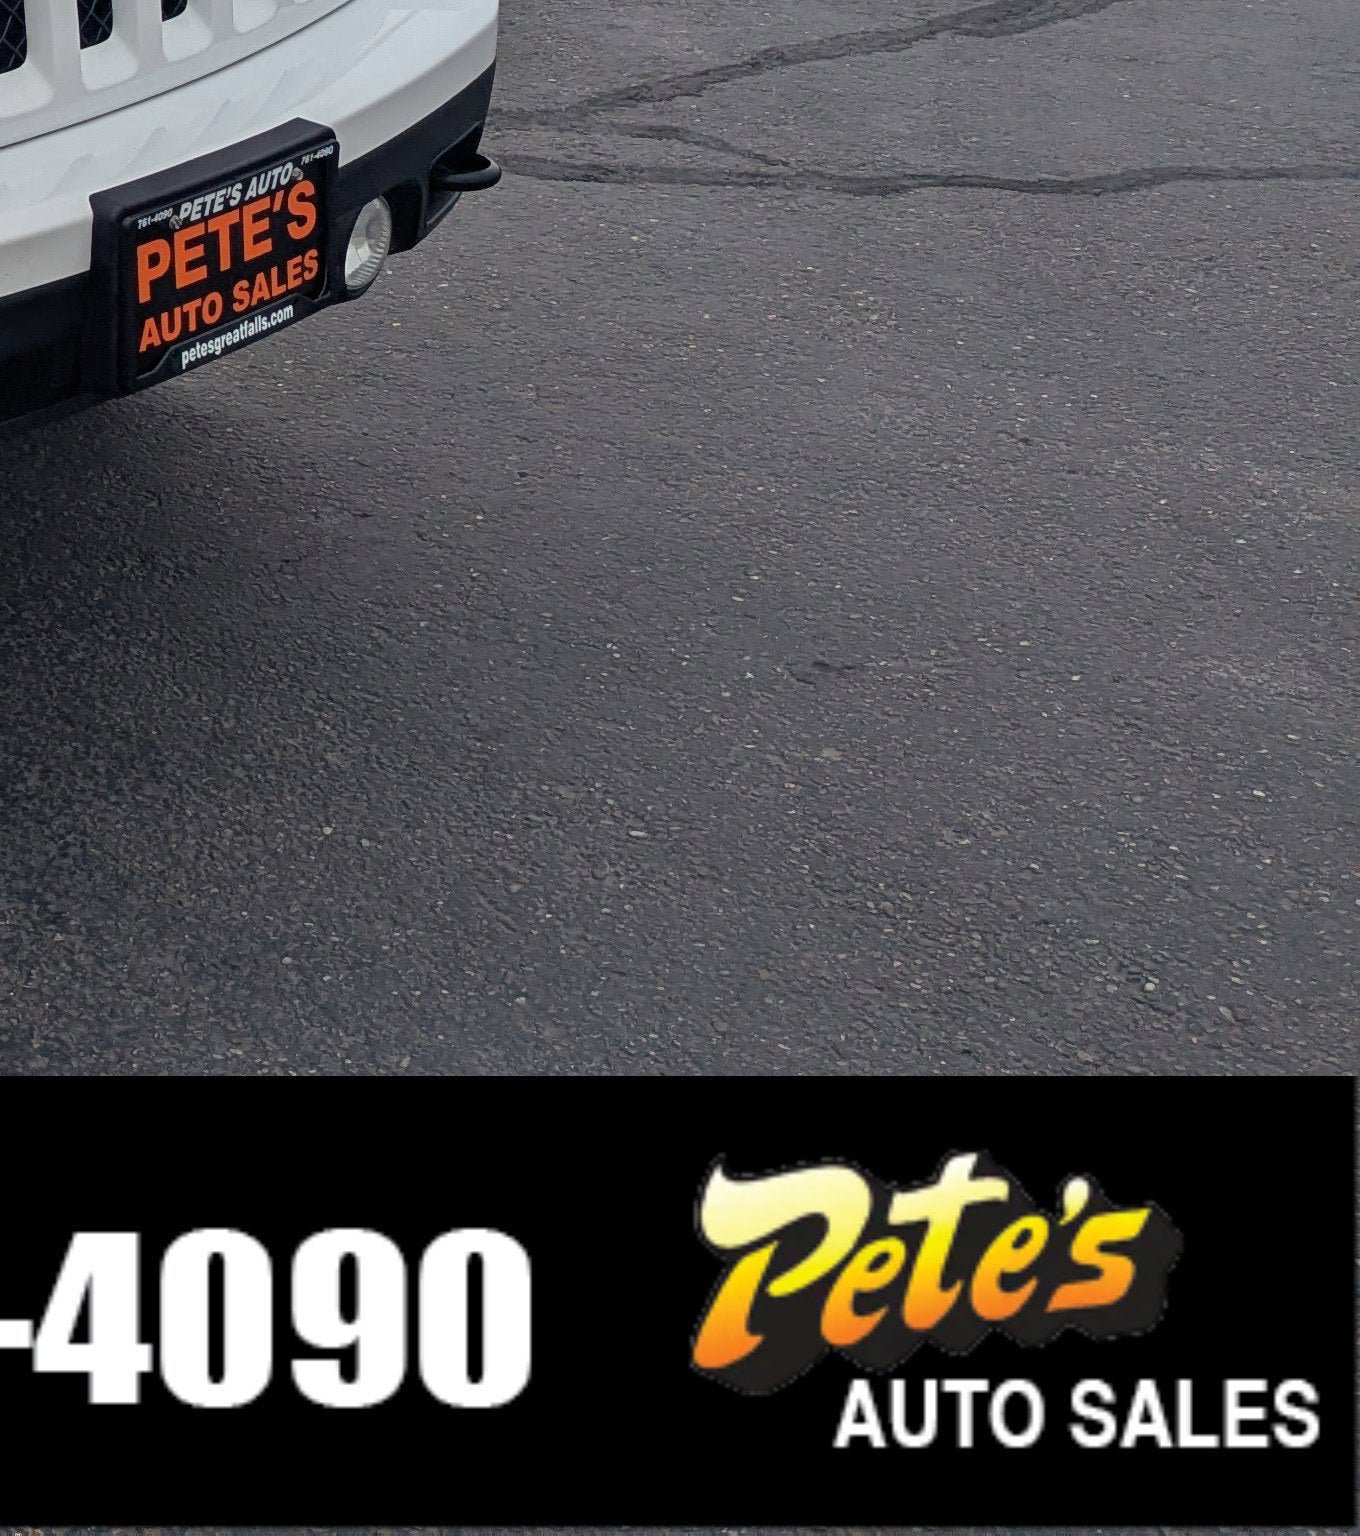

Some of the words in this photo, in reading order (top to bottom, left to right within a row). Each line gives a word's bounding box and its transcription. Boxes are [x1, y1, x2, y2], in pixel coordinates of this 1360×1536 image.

[180, 182, 243, 221] PETE'S
[244, 162, 294, 201] AUTO
[136, 179, 317, 305] PETE'S
[138, 291, 223, 353] AUTO
[232, 248, 319, 313] SALES
[181, 304, 294, 370] petesgreatfalls.com
